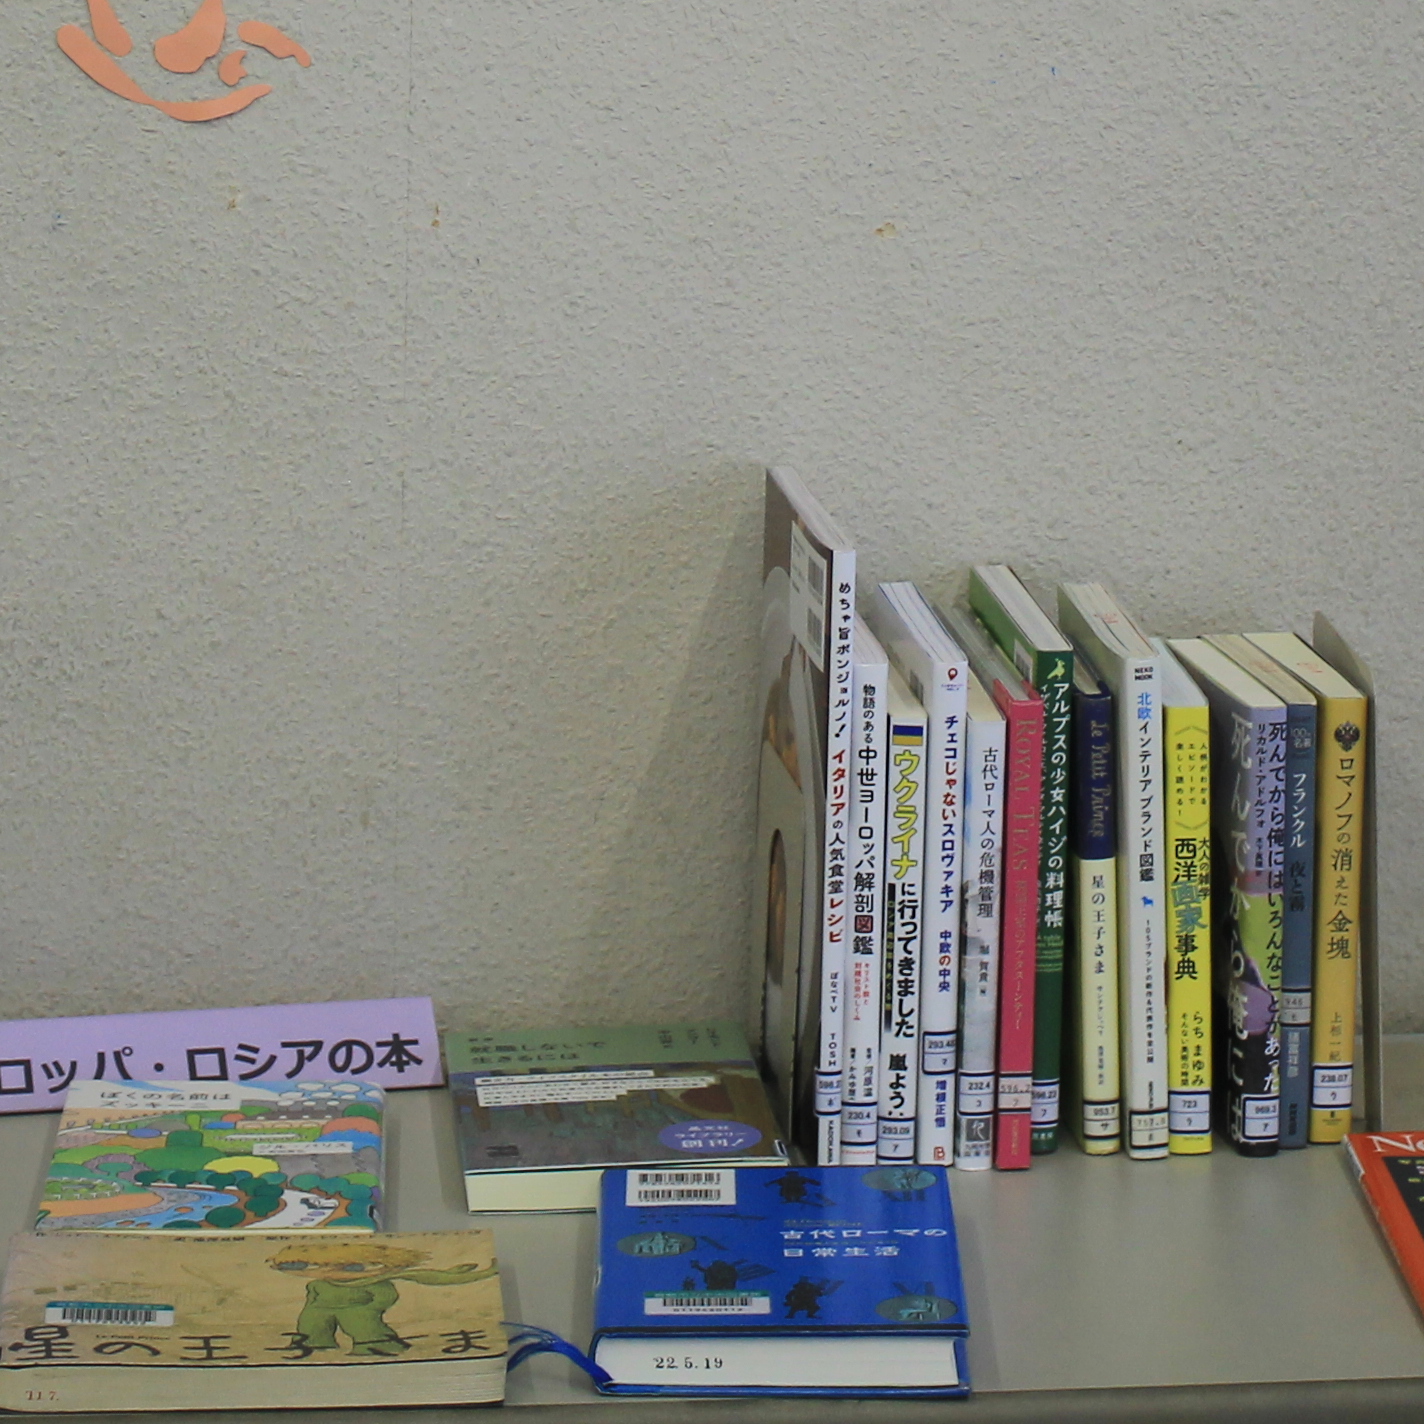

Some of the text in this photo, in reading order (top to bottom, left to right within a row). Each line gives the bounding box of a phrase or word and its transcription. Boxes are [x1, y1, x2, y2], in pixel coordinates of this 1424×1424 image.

[862, 684, 876, 744] 物語のある
[940, 716, 959, 914] チェコじゃないスロヴァキア
[977, 747, 999, 919] 古代ローマ人の危機管理
[1044, 683, 1070, 929] アルプスの少女ハイジの料理帳
[1290, 772, 1307, 848] フランクル
[827, 749, 847, 943] イタリアの人気食堂レシピ
[853, 746, 878, 955] 中世ヨーロッパ解剖図鑑
[1198, 838, 1210, 901] 大人の雑学
[1326, 758, 1356, 959] ロマノフの消えた金塊
[1090, 875, 1106, 975] 星の王子さま
[1171, 838, 1206, 980] 西洋画家事典
[938, 930, 952, 992] 中欧の中央
[828, 1033, 837, 1066] TOSH
[100, 1091, 232, 1101] ぼくの名前は
[888, 1054, 908, 1116] 嵐よう
[968, 1082, 991, 1090] 232.4
[1182, 1100, 1197, 1108] 723
[779, 1228, 948, 1240] 古代ローマの
[783, 1246, 901, 1258] 日常生活
[9, 1326, 489, 1361] 星の王子さま
